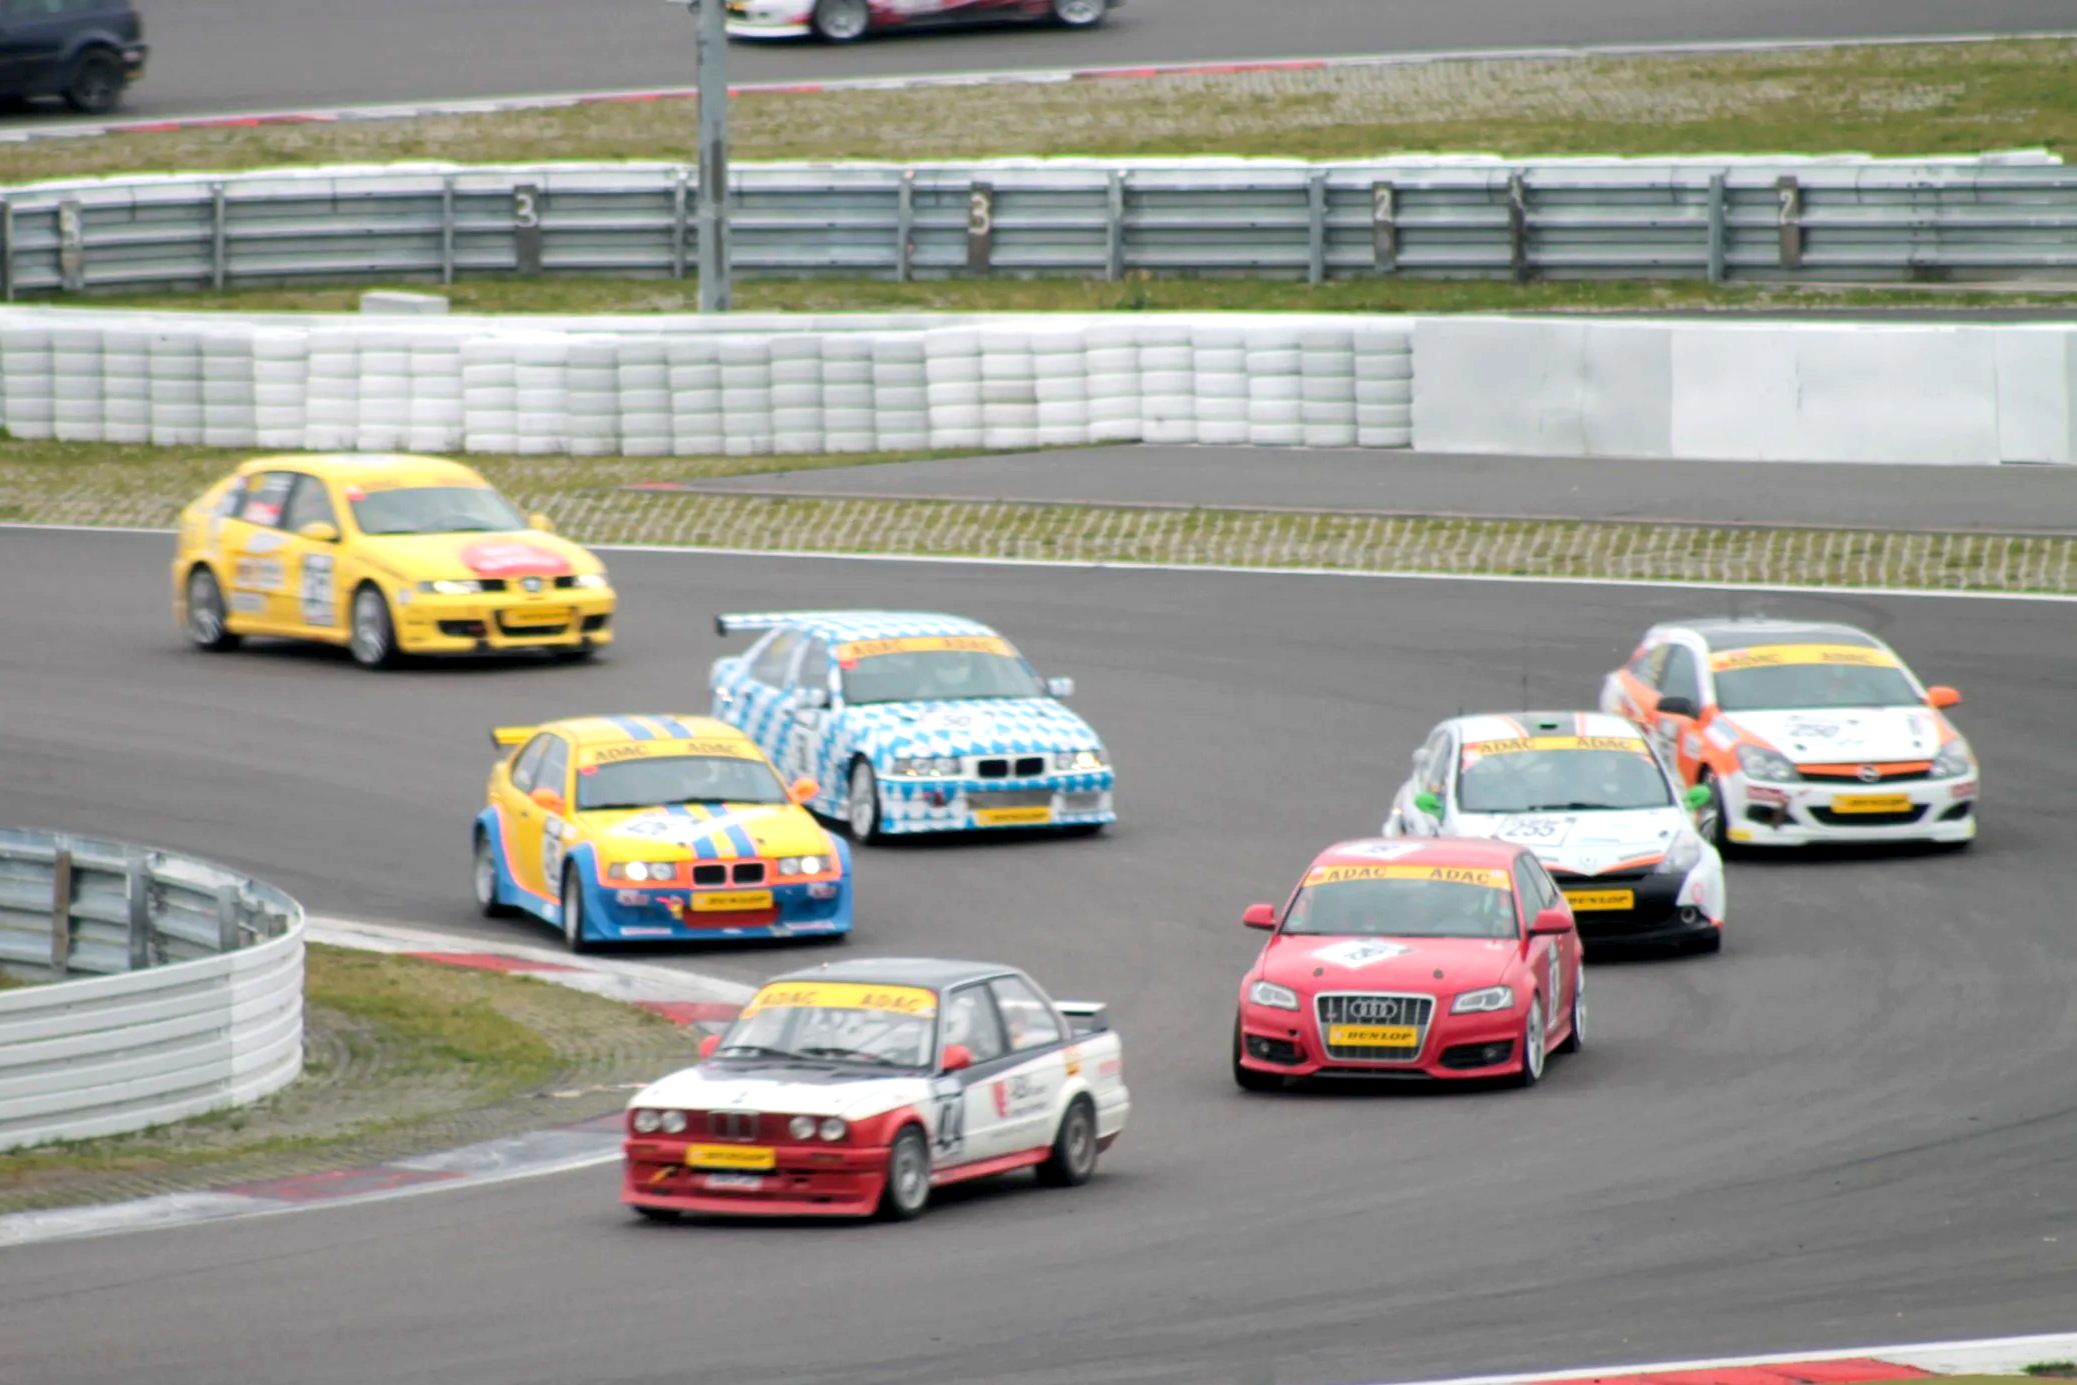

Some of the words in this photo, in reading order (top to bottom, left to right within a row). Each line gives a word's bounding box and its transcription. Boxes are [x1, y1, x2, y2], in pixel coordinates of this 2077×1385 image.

[516, 193, 537, 228] 3
[968, 194, 990, 235] 3
[1374, 190, 1392, 222] 2
[1780, 190, 1799, 225] 2
[595, 745, 649, 762] ADAC
[687, 743, 739, 756] ADAC
[1479, 738, 1537, 753] ADAC
[1576, 737, 1632, 750] ADAC
[1504, 821, 1556, 837] 255
[1327, 867, 1388, 882] ADAC
[1430, 868, 1491, 885] ADAC
[761, 991, 822, 1006] ADAC
[859, 993, 923, 1012] ADAC
[1346, 1031, 1412, 1041] DUNLOP
